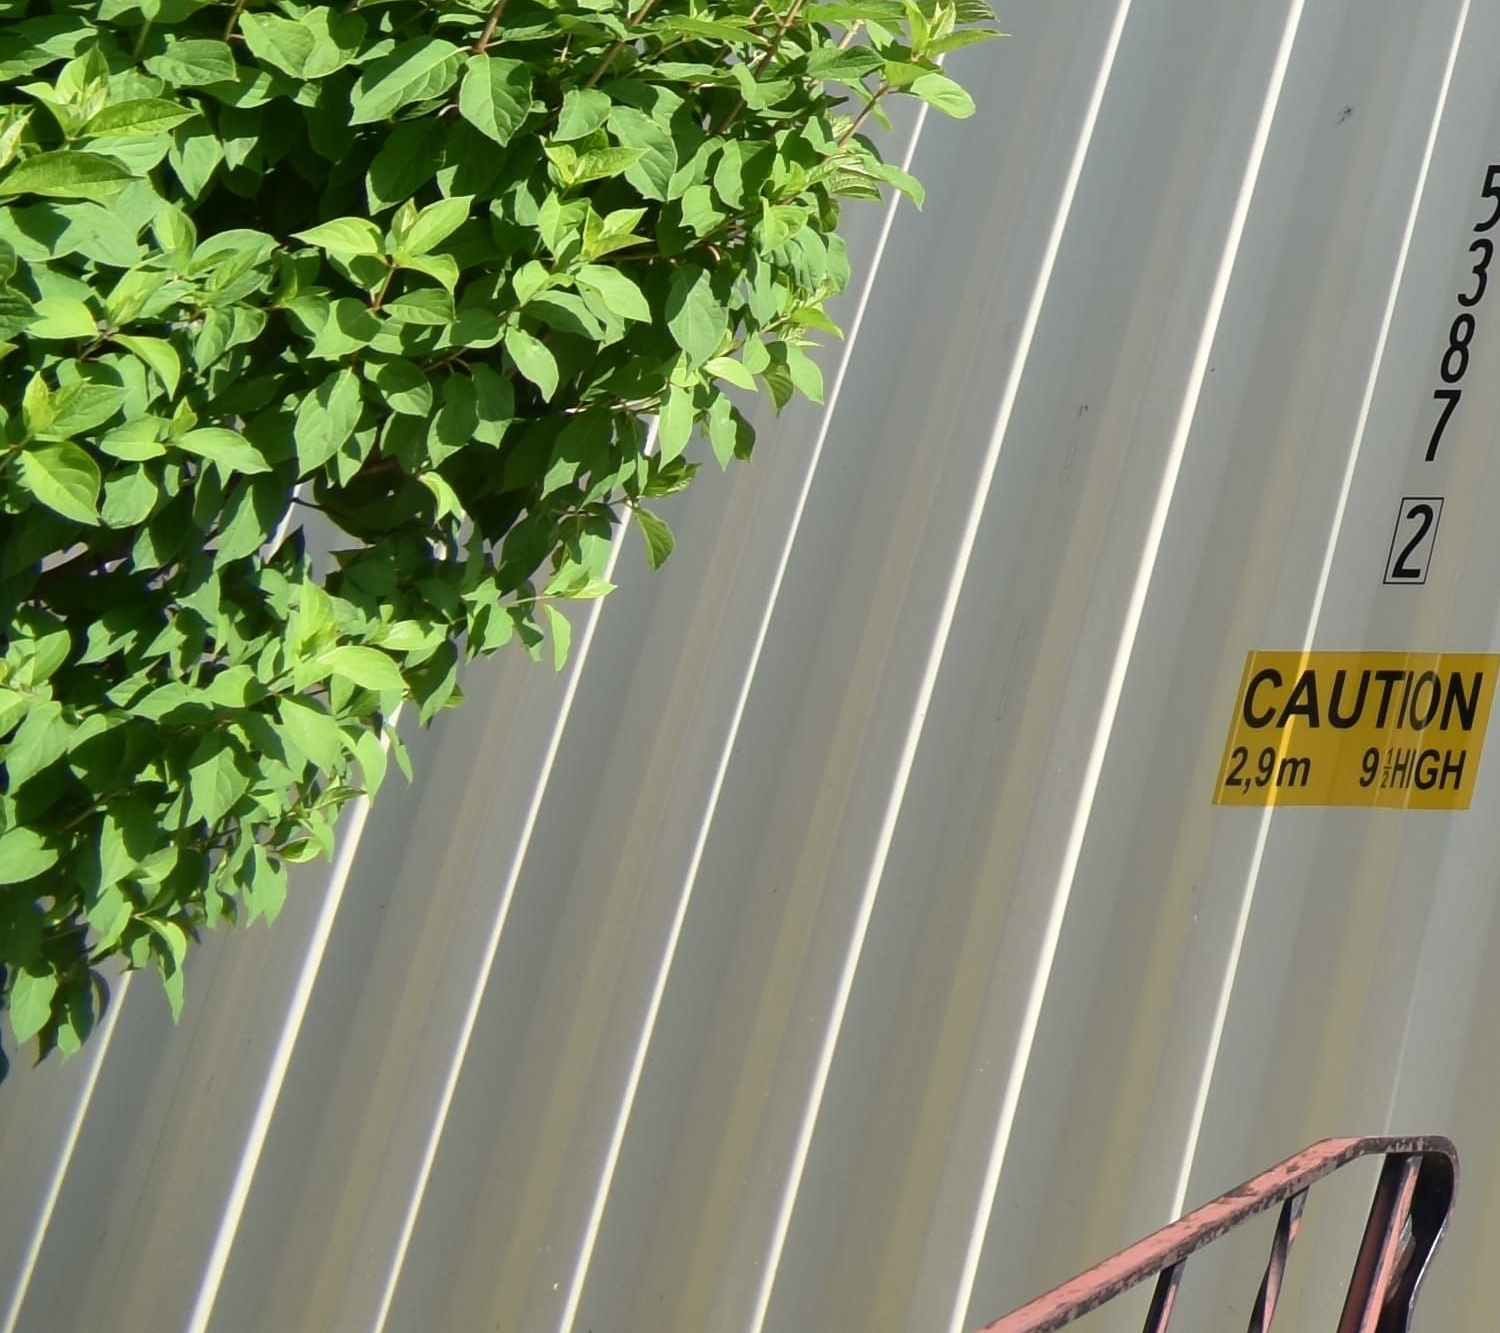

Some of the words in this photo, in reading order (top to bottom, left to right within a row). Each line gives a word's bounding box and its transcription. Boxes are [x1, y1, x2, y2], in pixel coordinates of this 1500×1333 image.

[1391, 503, 1434, 579] 2
[1242, 668, 1484, 732] CAUTION
[1225, 746, 1311, 794] 2,9m
